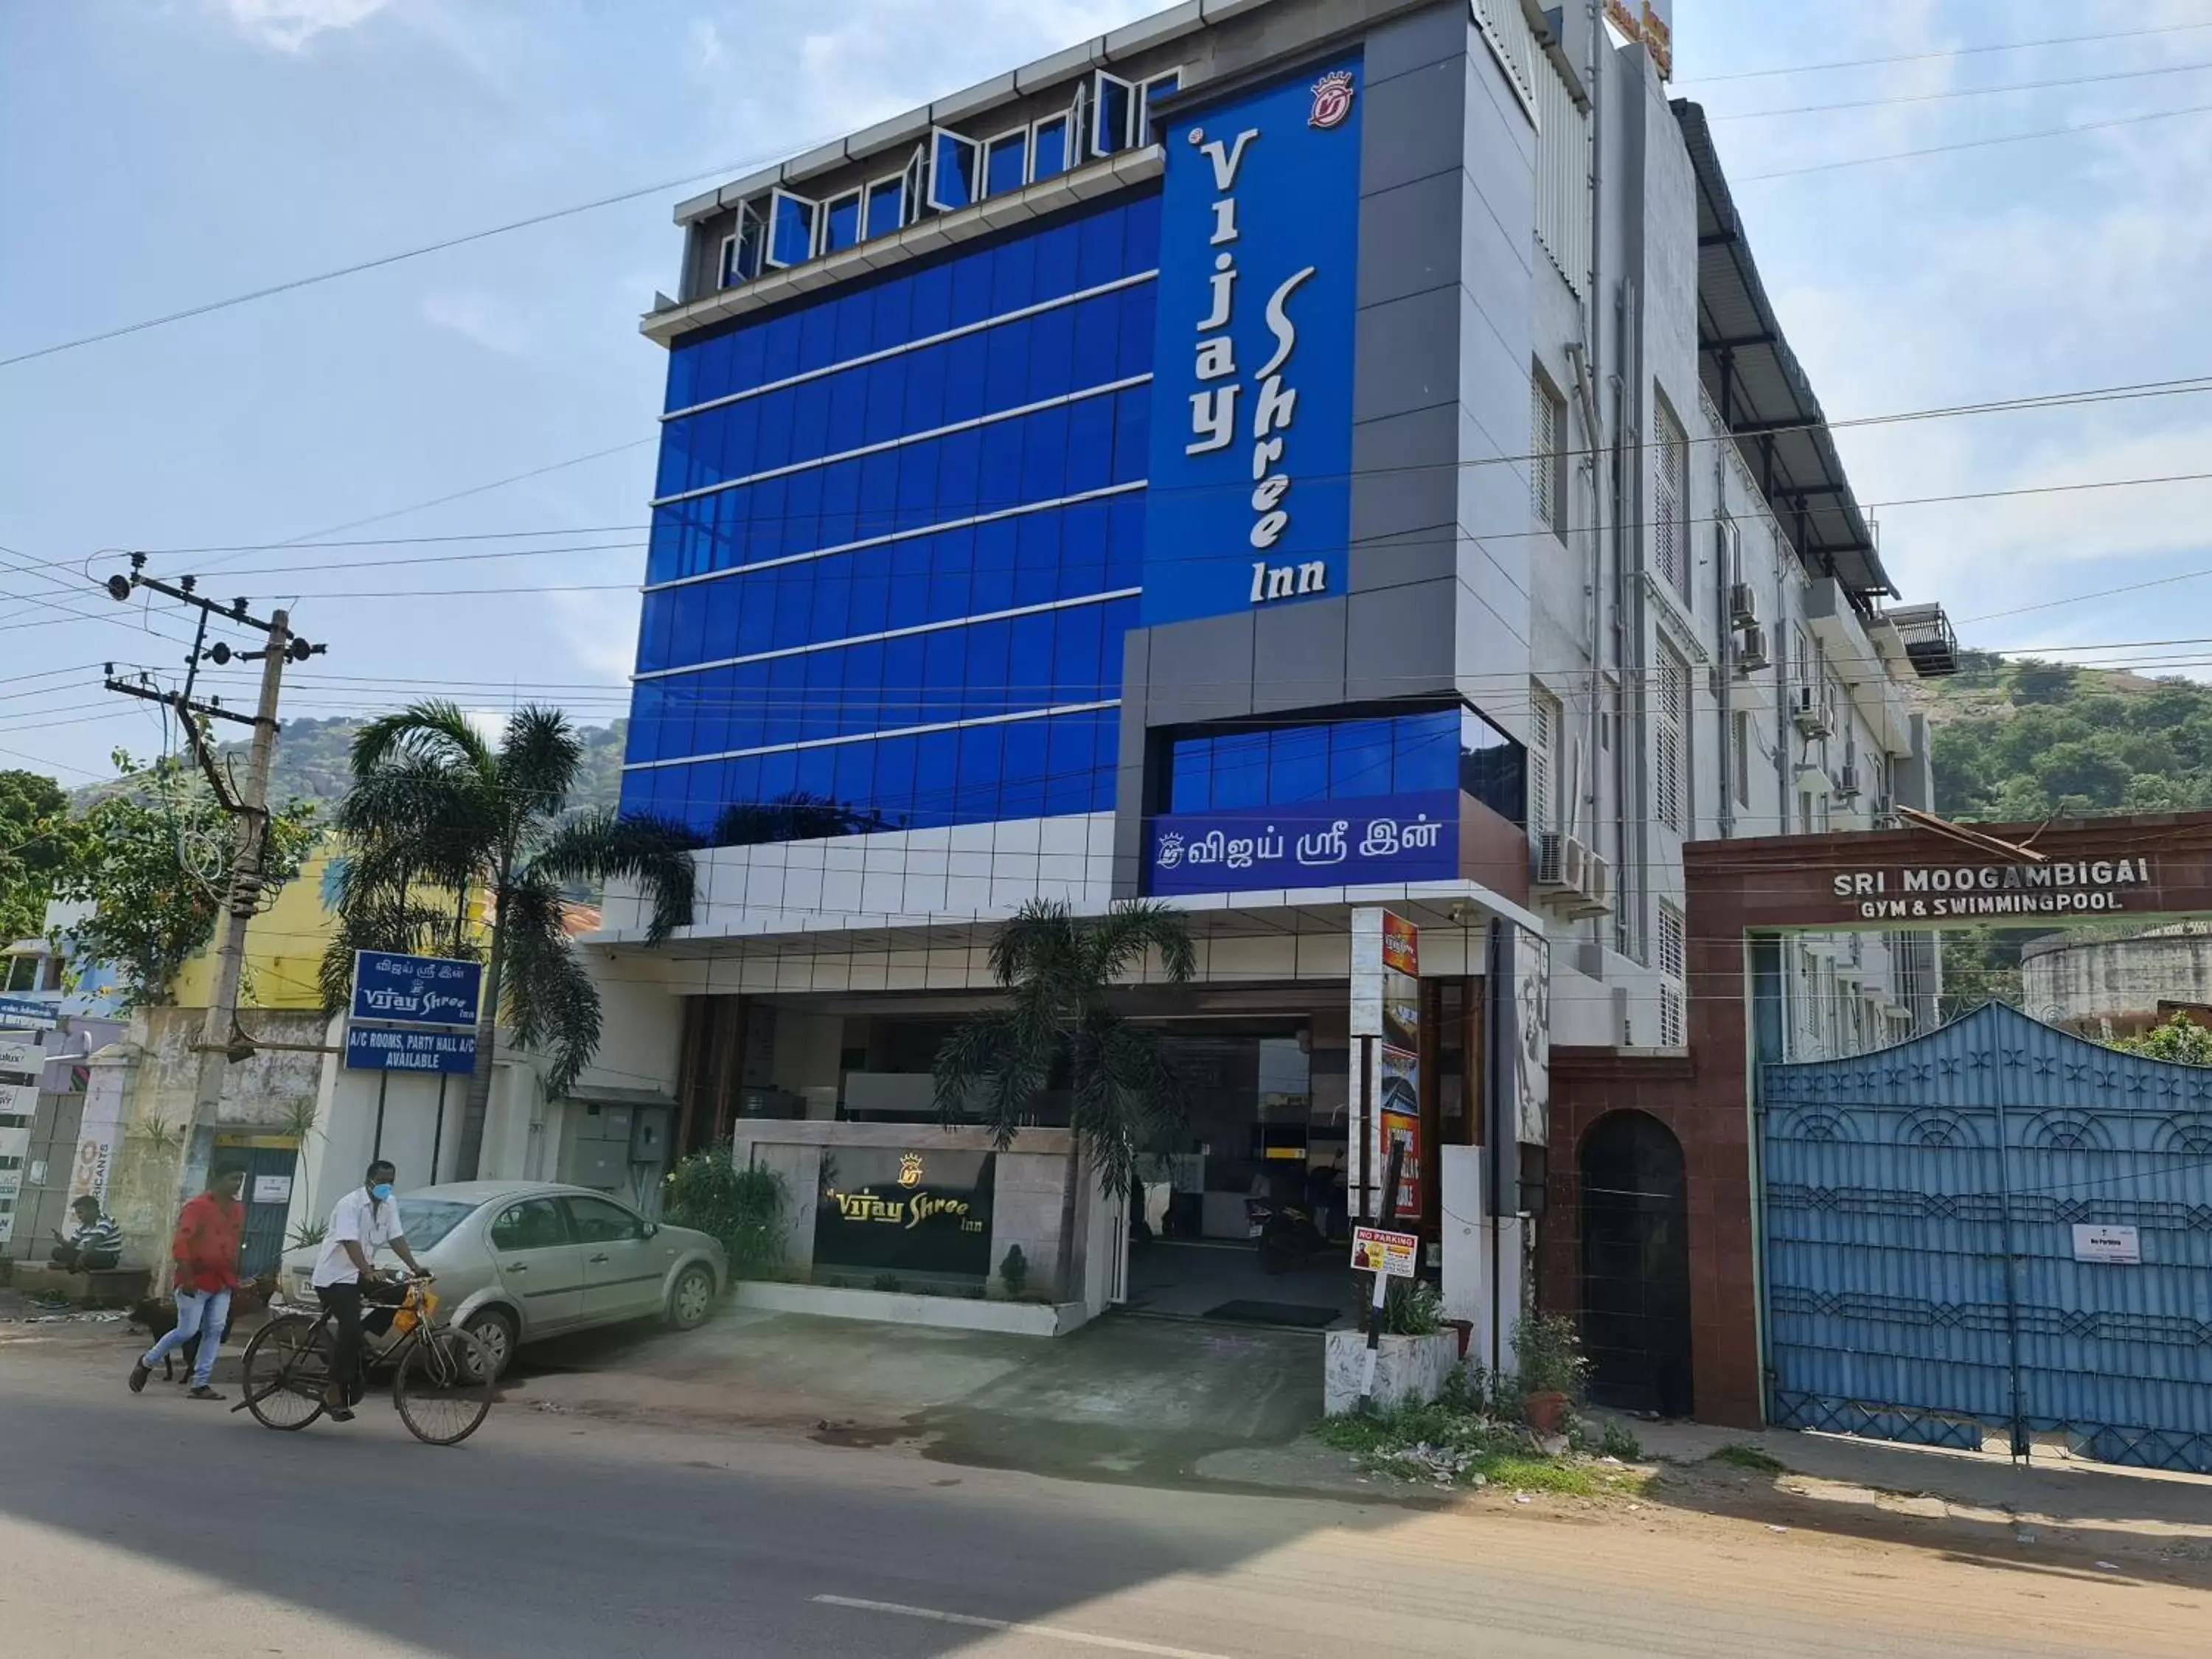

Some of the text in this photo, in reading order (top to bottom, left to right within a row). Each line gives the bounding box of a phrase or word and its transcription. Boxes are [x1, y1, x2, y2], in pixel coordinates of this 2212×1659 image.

[1250, 266, 1315, 549] Shree
[1251, 560, 1326, 603] Inn
[1189, 825, 1284, 869] விஜய்
[1360, 813, 1442, 856] இன்
[1833, 858, 2149, 896] SRI MOOGAMBIGAI
[1861, 899, 1906, 917] GYM
[1913, 898, 1927, 916] &
[375, 959, 414, 975] விஜய்
[438, 966, 464, 979] இன்
[419, 991, 467, 1015] Shree
[349, 1032, 474, 1052] A/C ROOMS, PARTY HALL A/C
[386, 1051, 439, 1068] AVAILABLE
[905, 1192, 970, 1229] Shree
[961, 1217, 982, 1232] Inn
[1359, 1231, 1413, 1246] NO PARKING
